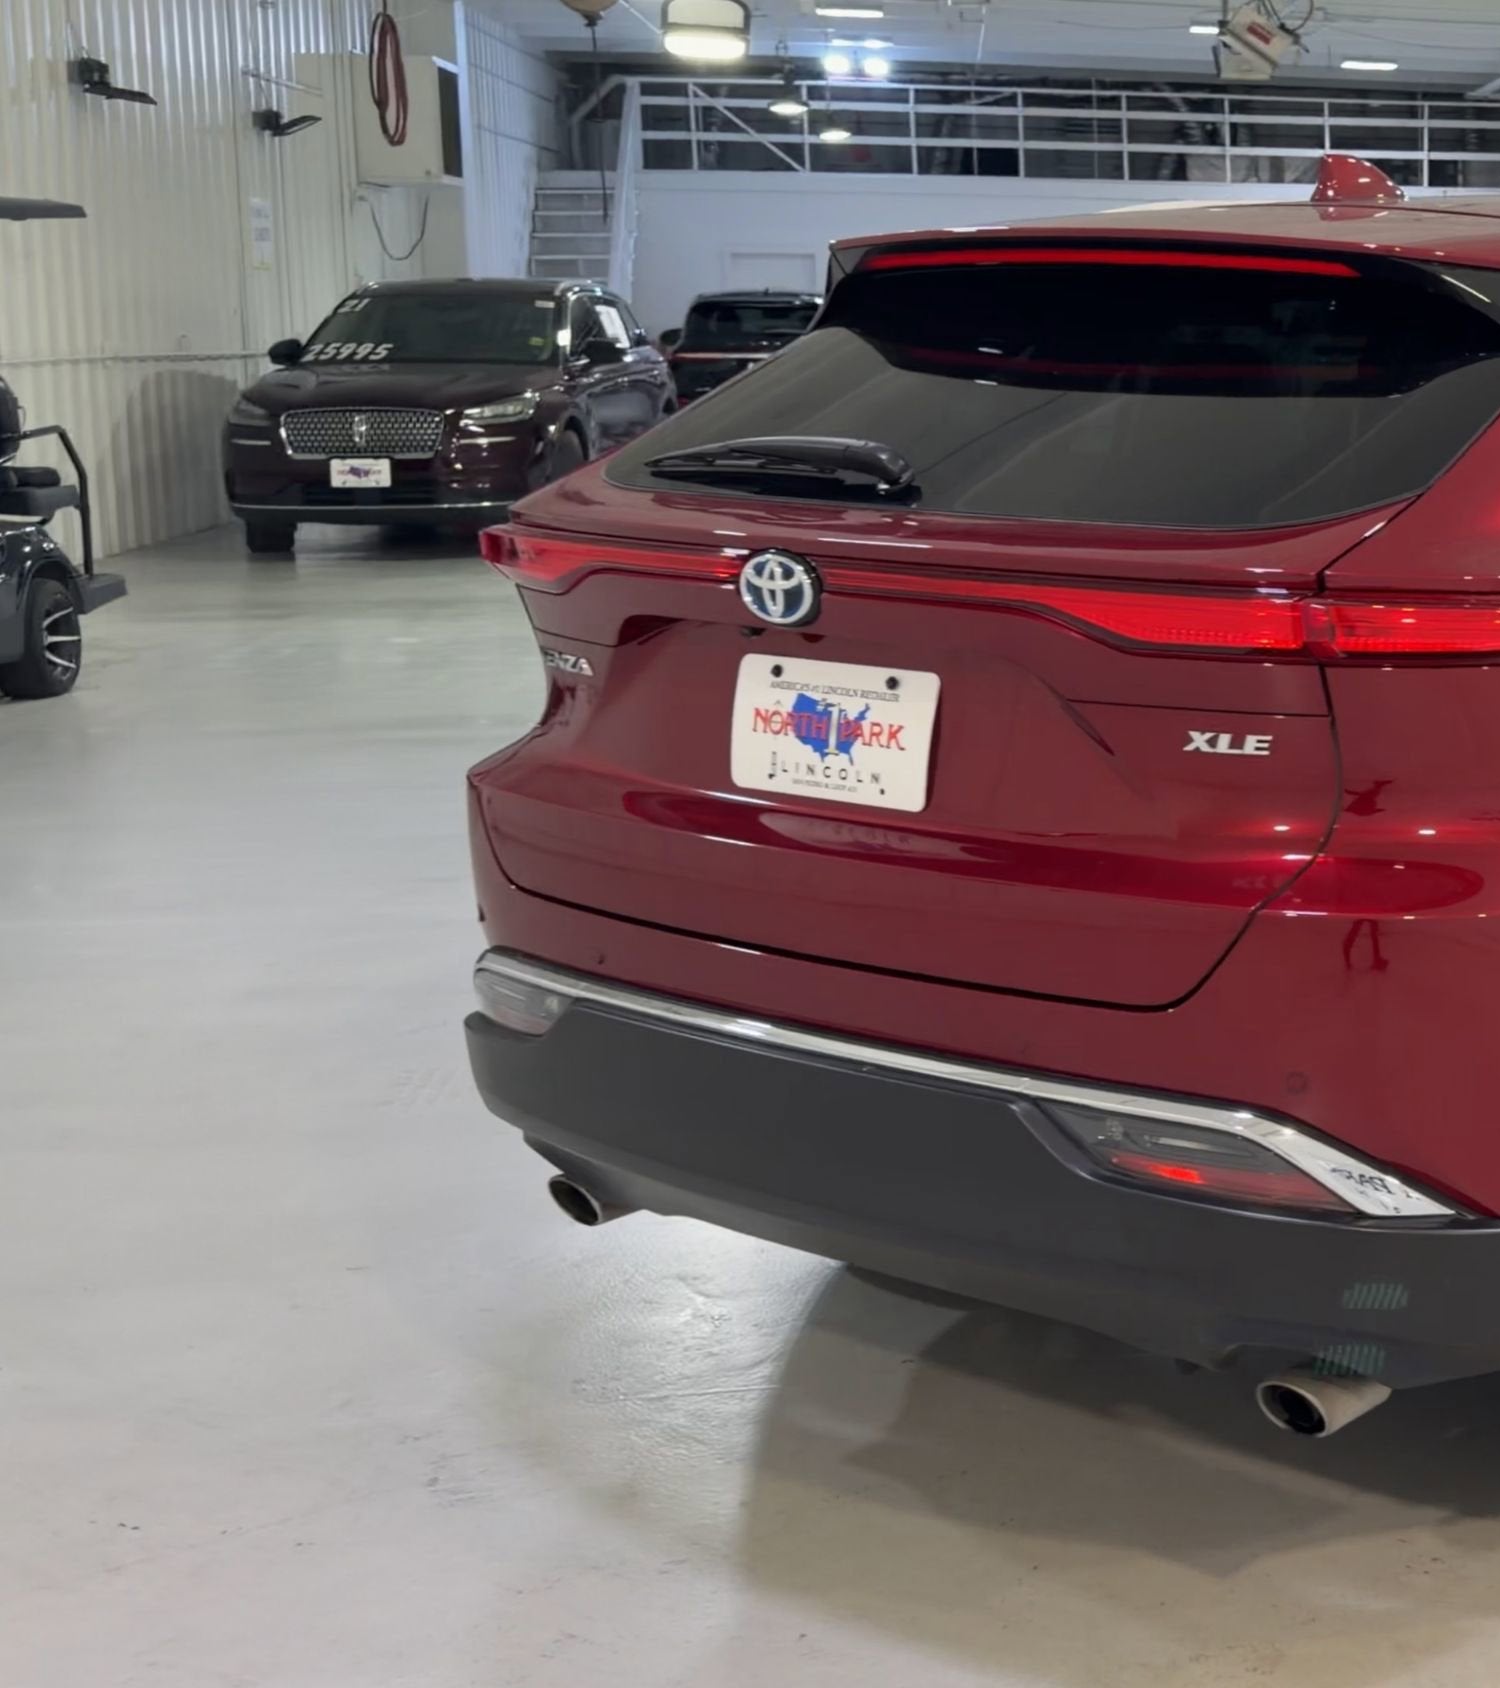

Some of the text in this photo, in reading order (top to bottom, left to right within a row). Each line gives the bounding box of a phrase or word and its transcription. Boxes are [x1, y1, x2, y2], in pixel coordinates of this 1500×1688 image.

[337, 298, 371, 313] 21
[301, 343, 394, 362] 25995
[752, 707, 907, 751] NORTH PARK
[1182, 730, 1273, 756] XLE
[781, 760, 881, 784] LINCOLN
